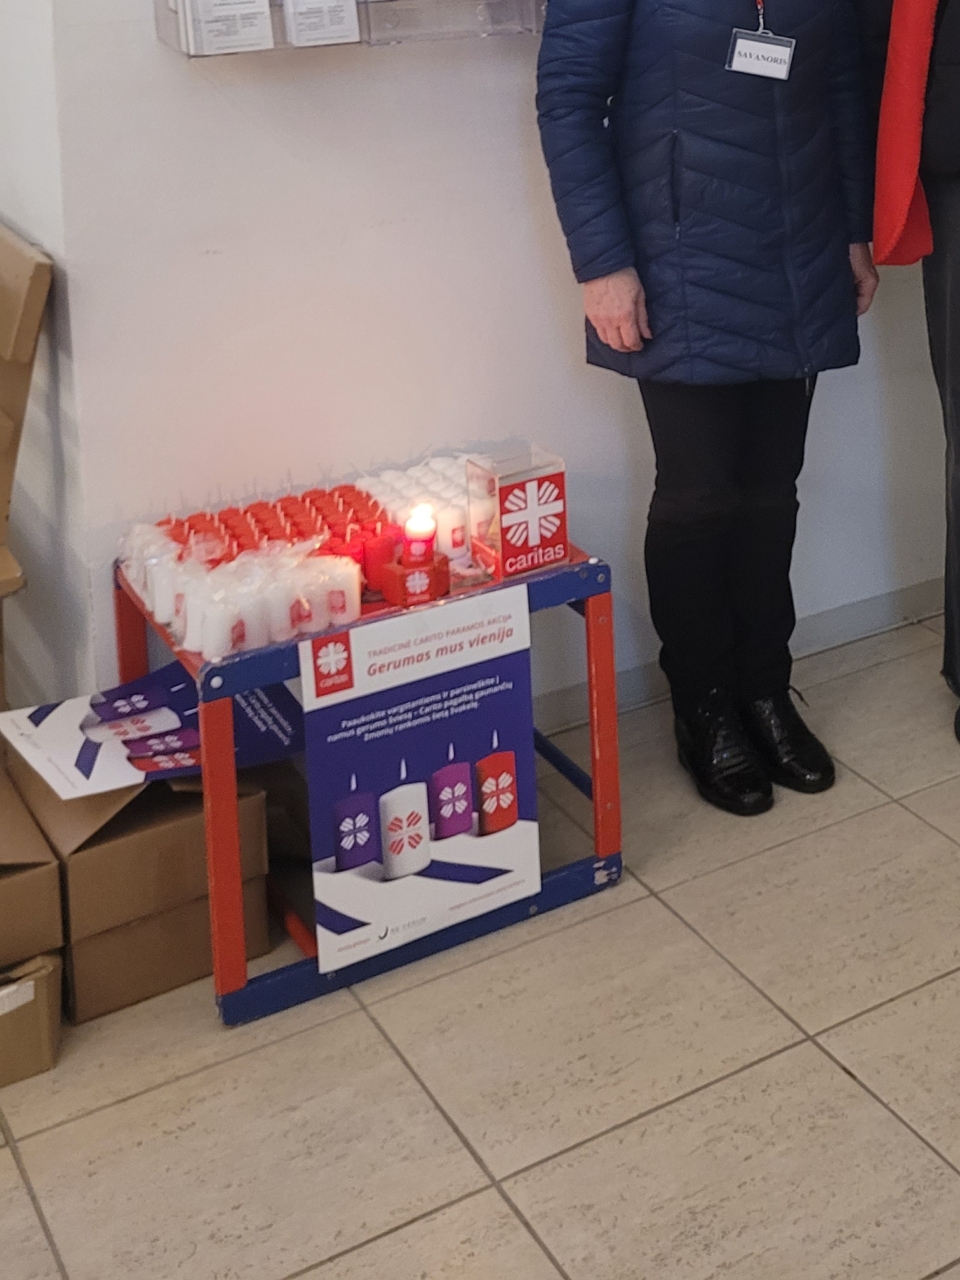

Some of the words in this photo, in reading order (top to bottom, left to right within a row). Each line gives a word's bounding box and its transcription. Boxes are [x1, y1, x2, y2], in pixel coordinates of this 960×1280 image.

[737, 51, 788, 65] SAVANORIS
[505, 544, 565, 573] caritas
[413, 632, 443, 646] CARITO
[445, 622, 485, 639] PARAMOS
[367, 650, 430, 677] Gerumas
[435, 641, 464, 658] mus
[468, 626, 514, 648] vienija
